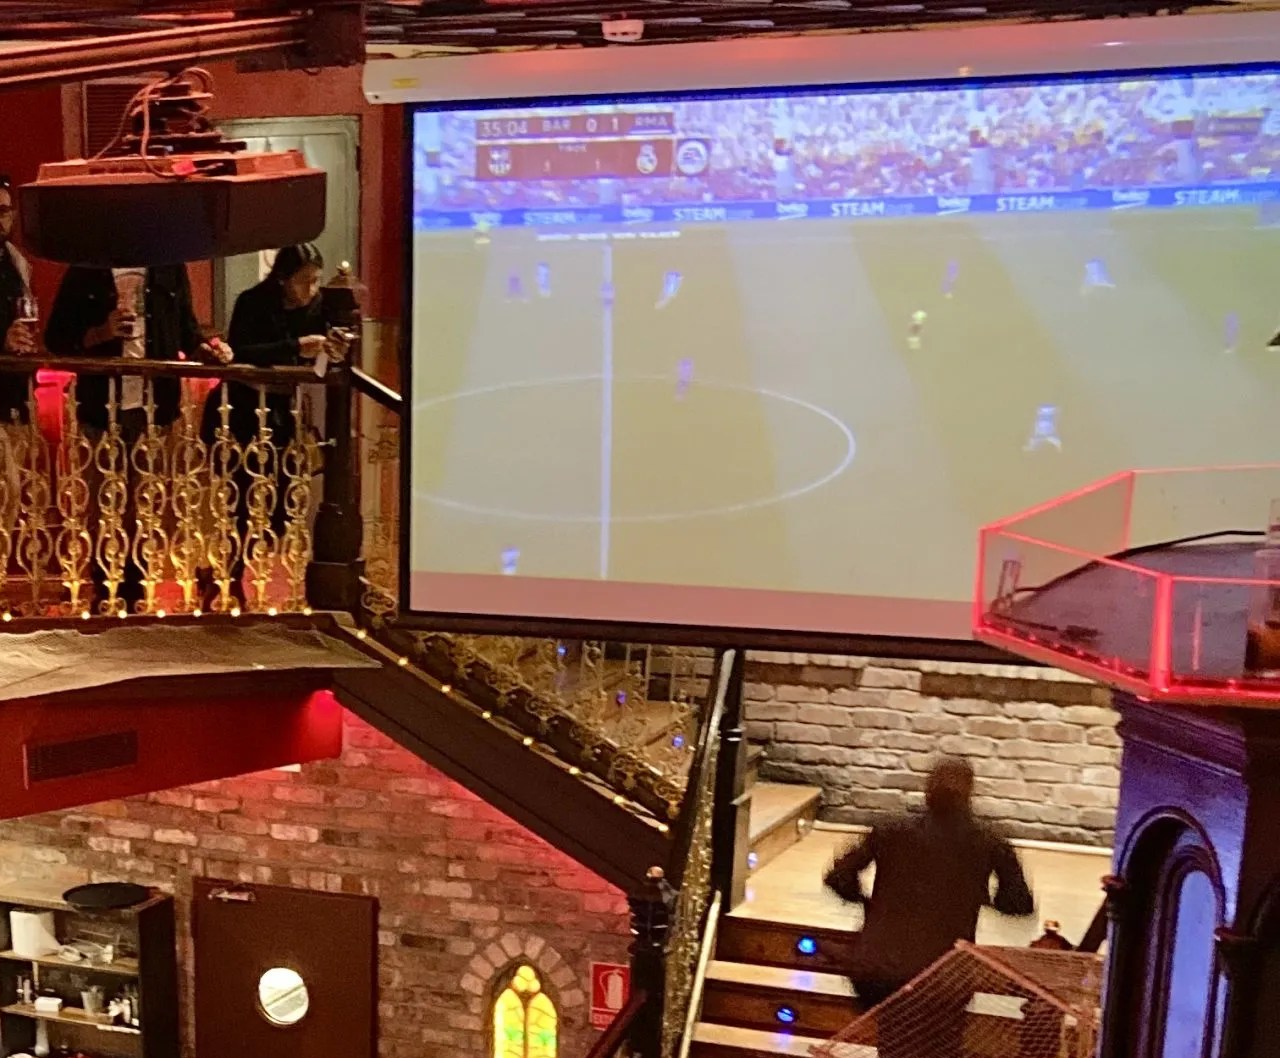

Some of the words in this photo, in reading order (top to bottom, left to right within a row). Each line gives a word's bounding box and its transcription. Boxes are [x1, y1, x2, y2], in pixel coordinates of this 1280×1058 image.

[542, 117, 571, 131] BAR
[586, 118, 597, 132] 0
[612, 118, 619, 131] 1
[673, 207, 727, 221] STEAM
[831, 201, 885, 217] STEAM
[996, 195, 1055, 212] STEAM
[1174, 189, 1240, 205] STEAM
